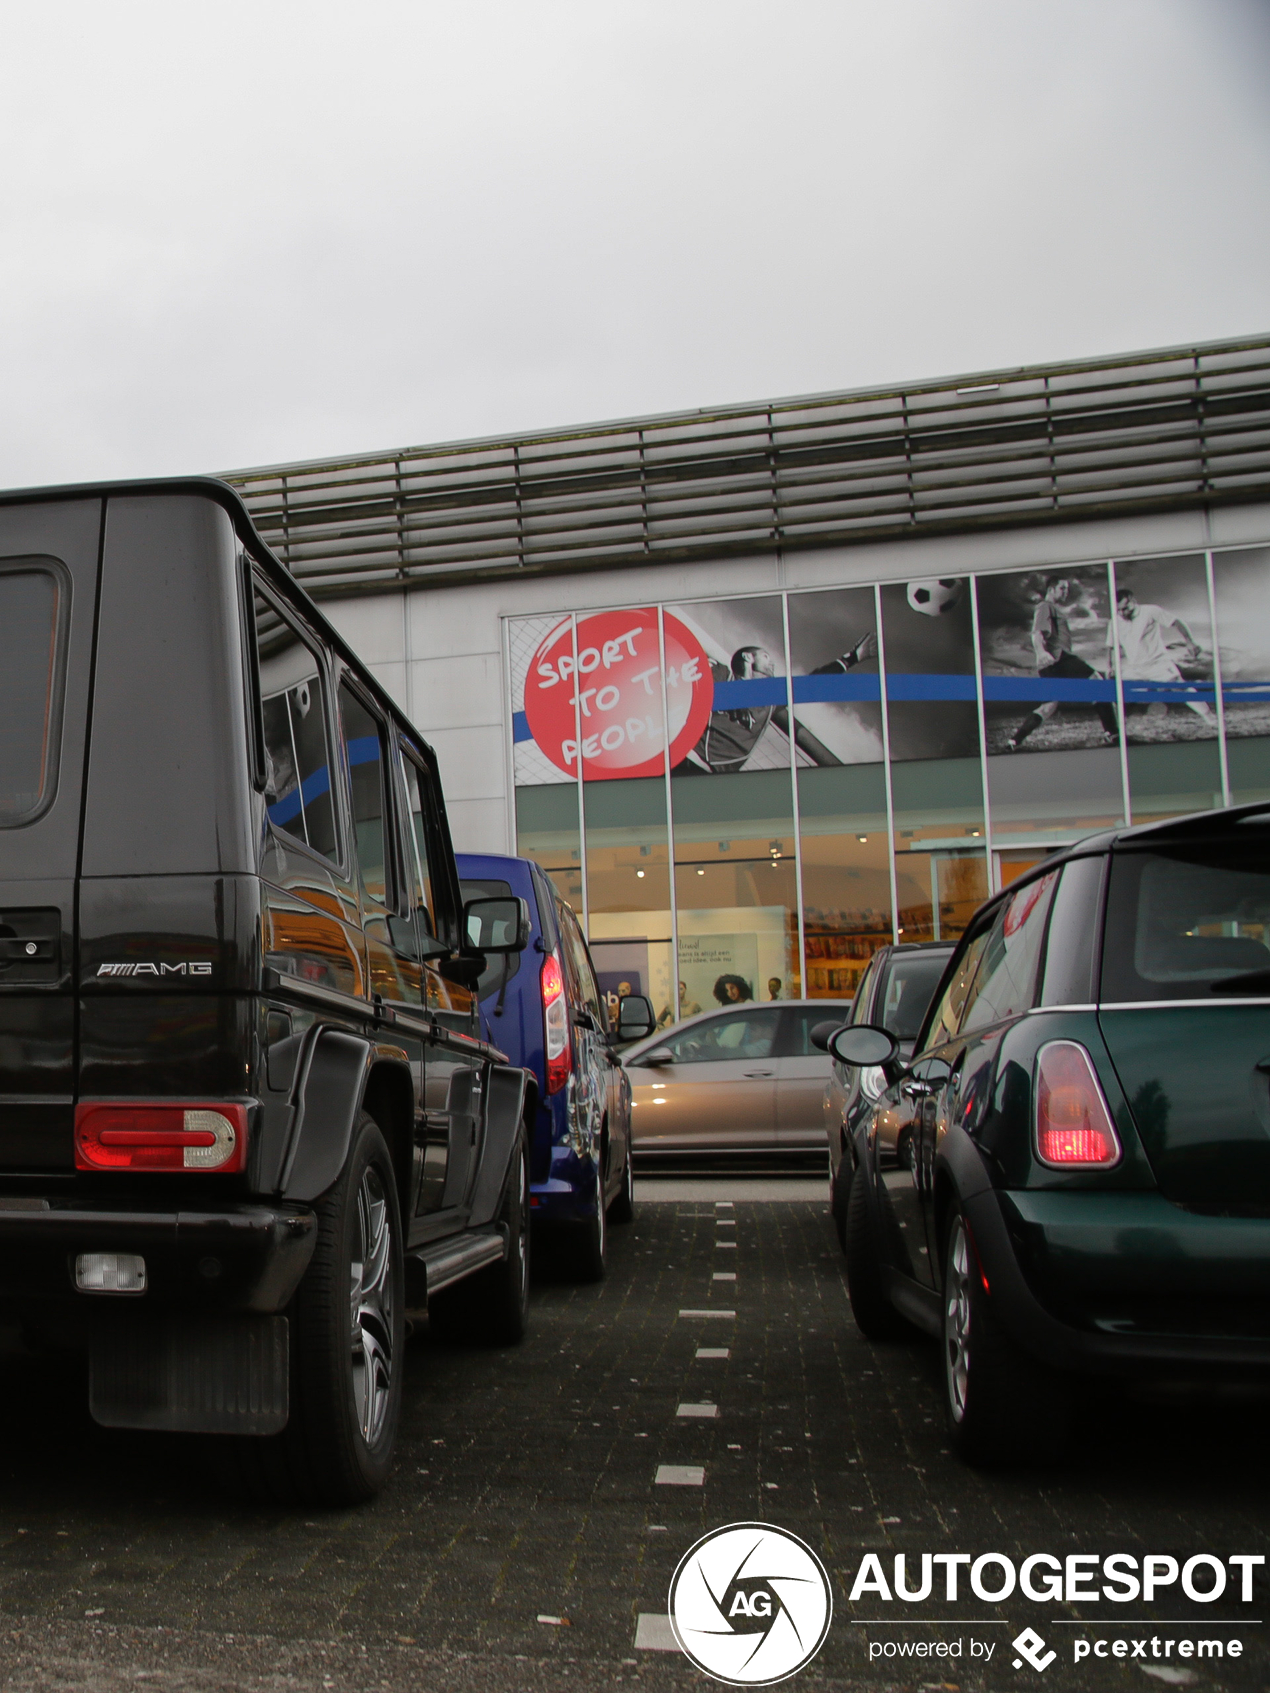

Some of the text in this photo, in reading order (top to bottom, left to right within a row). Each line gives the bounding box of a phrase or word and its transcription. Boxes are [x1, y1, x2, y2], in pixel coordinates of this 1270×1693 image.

[537, 627, 643, 689] SPORT
[569, 656, 703, 717] TO THE
[561, 706, 683, 765] PEOPL
[132, 962, 212, 976] AMG
